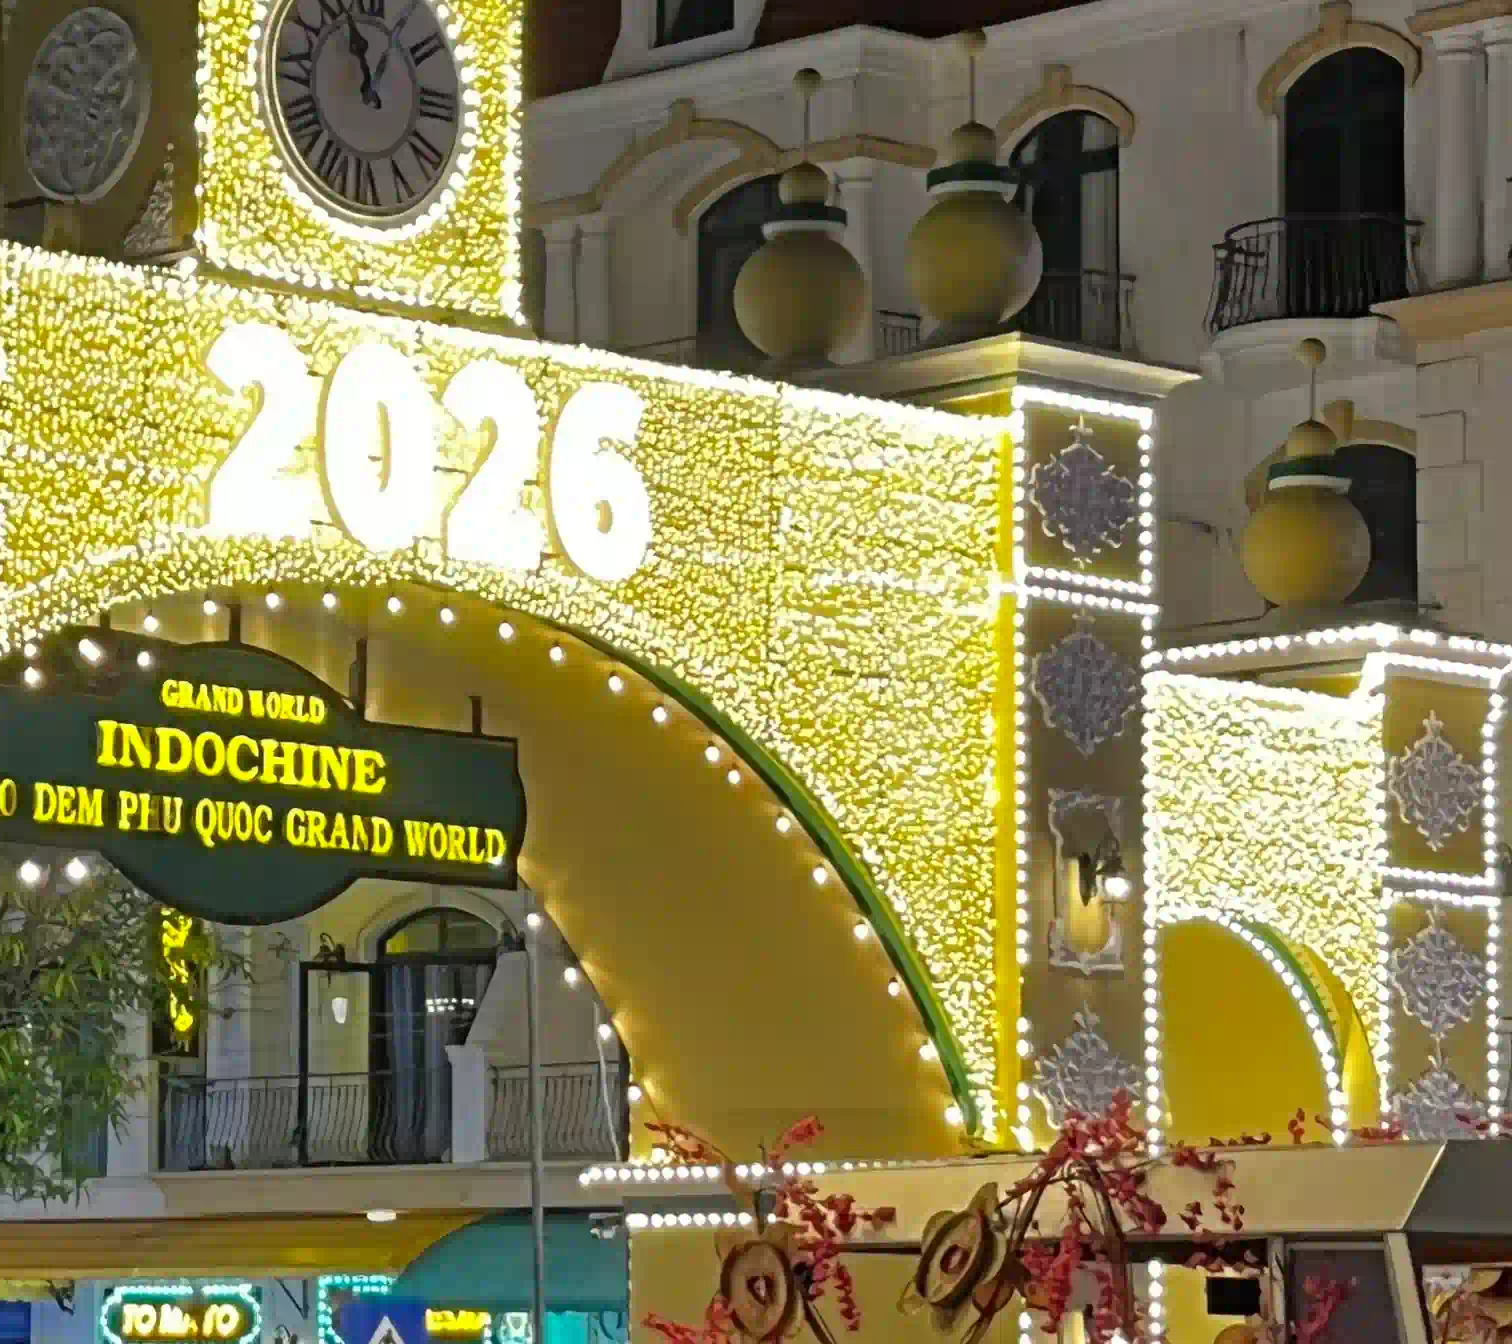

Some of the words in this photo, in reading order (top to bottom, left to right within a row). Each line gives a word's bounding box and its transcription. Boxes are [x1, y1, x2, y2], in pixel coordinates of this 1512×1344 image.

[202, 322, 653, 582] 2026
[160, 678, 244, 716] GRAND
[248, 689, 327, 725] WORLD
[96, 719, 387, 794] INDOCHINE
[33, 781, 104, 828] DEM
[118, 790, 184, 835] PHU
[194, 797, 273, 848] QUOC
[285, 806, 394, 856] GRAND
[402, 819, 507, 866] WORLD
